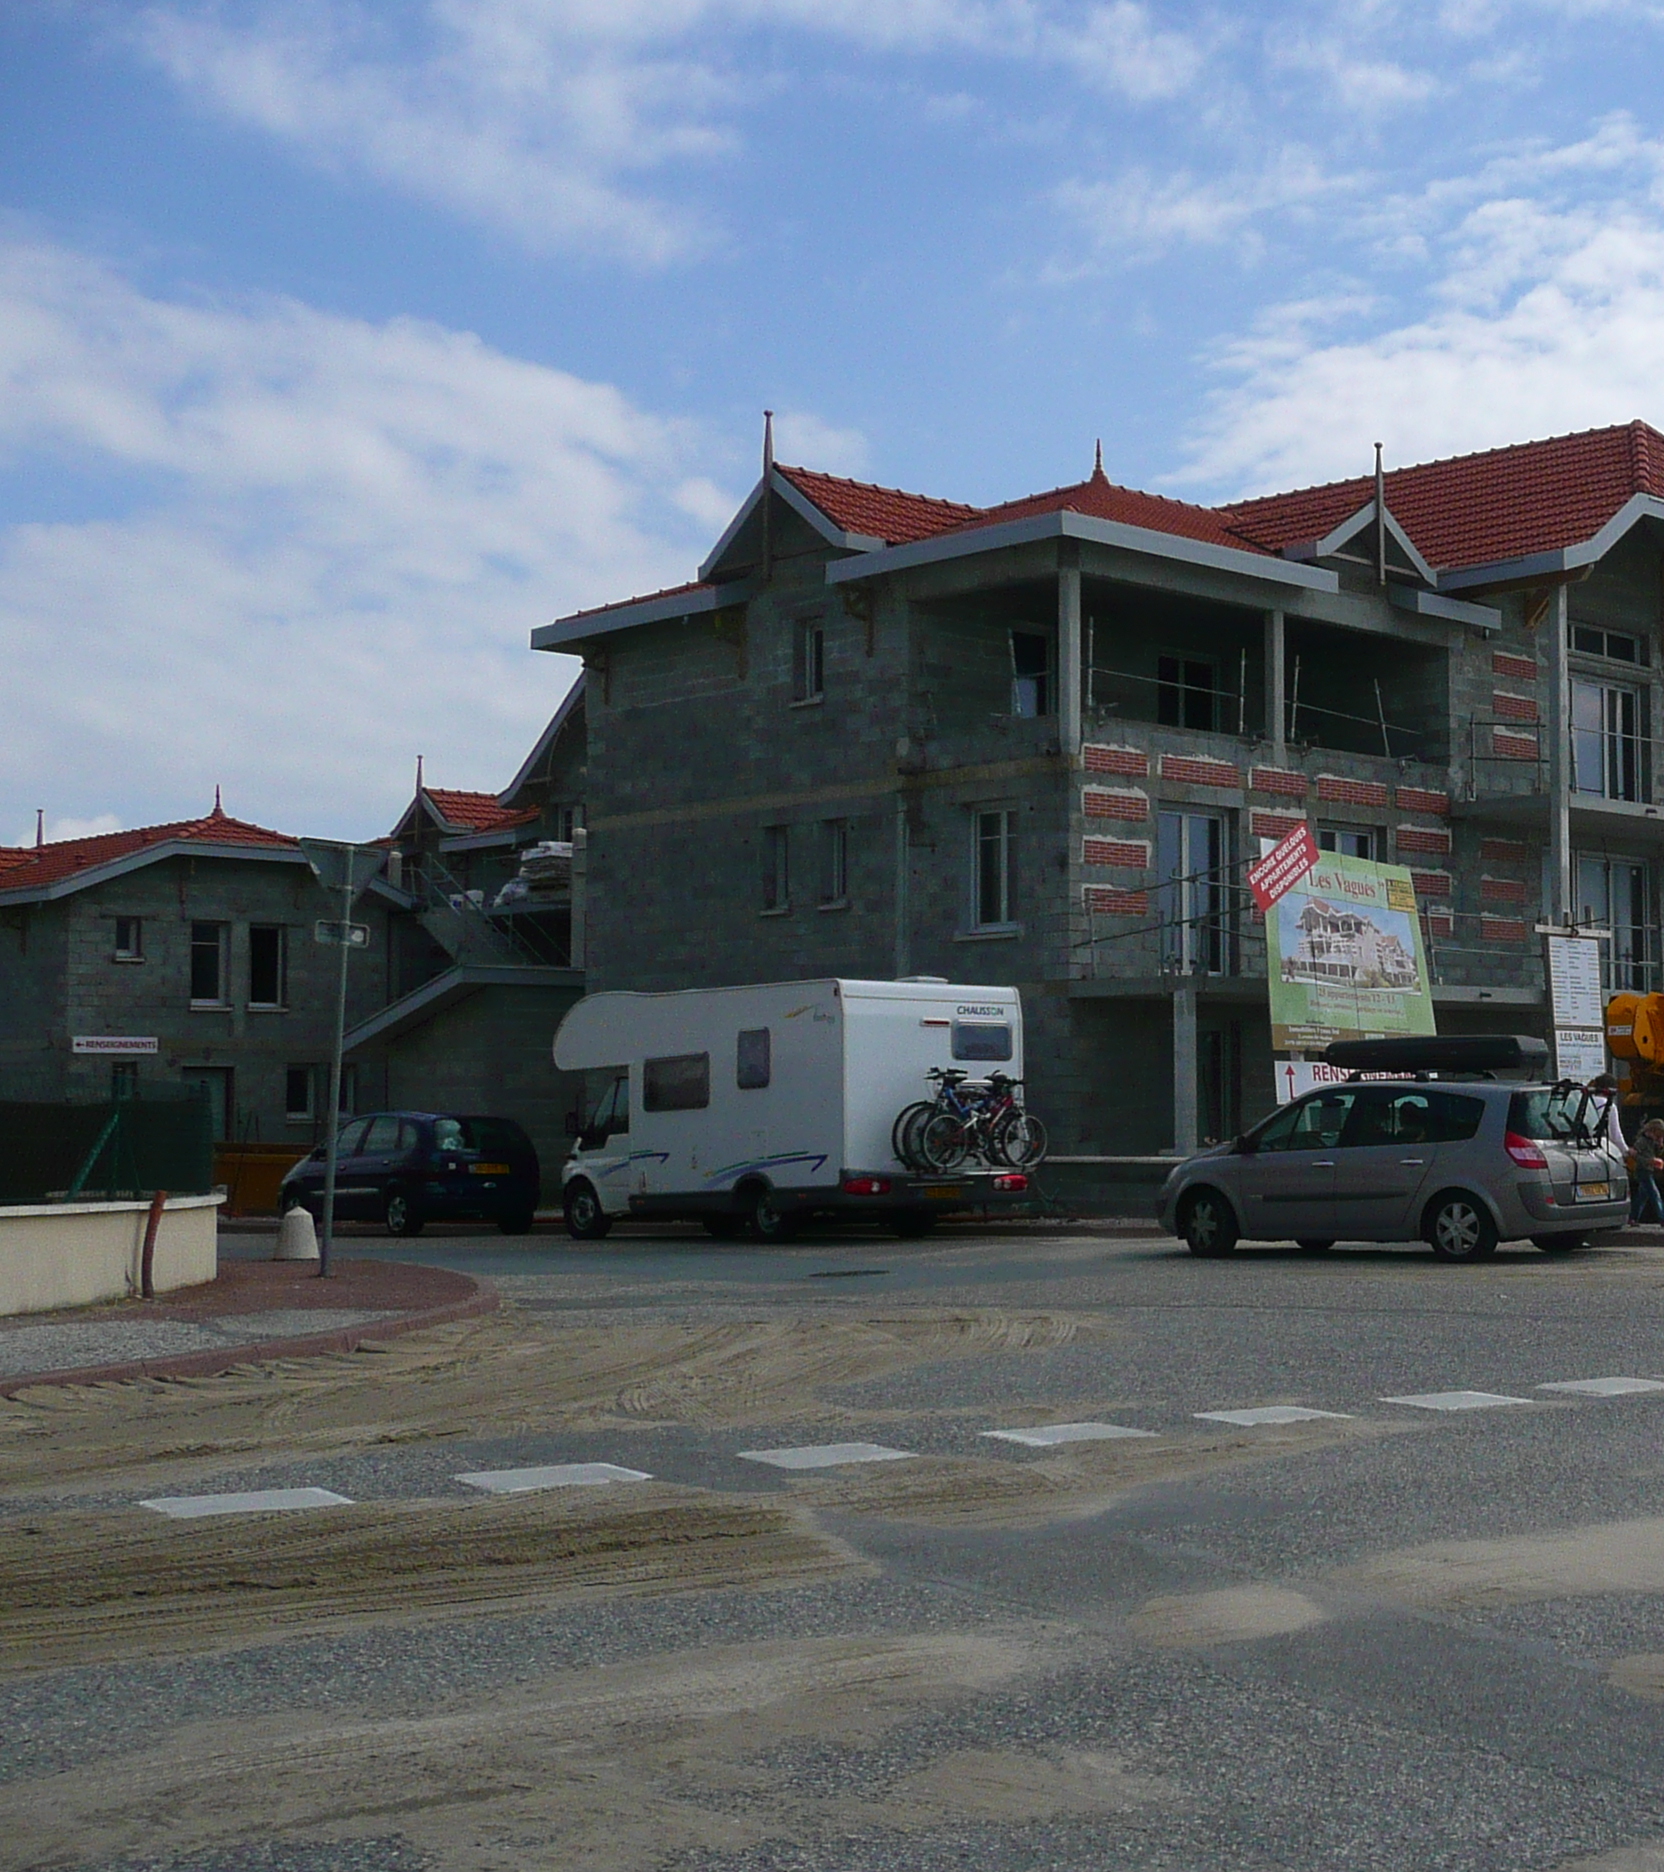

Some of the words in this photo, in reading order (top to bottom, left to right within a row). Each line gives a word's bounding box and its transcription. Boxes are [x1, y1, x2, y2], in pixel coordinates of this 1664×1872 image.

[1249, 855, 1277, 885] ENCORE
[1275, 826, 1307, 860] QUELQUES
[1260, 843, 1307, 892] APPARTEMENTS
[1269, 857, 1309, 899] DISPONIBLES
[1309, 868, 1332, 890] Les
[957, 1005, 1004, 1016] CHAUSSON
[1560, 1032, 1572, 1041] LES
[1574, 1033, 1599, 1043] VAGUES
